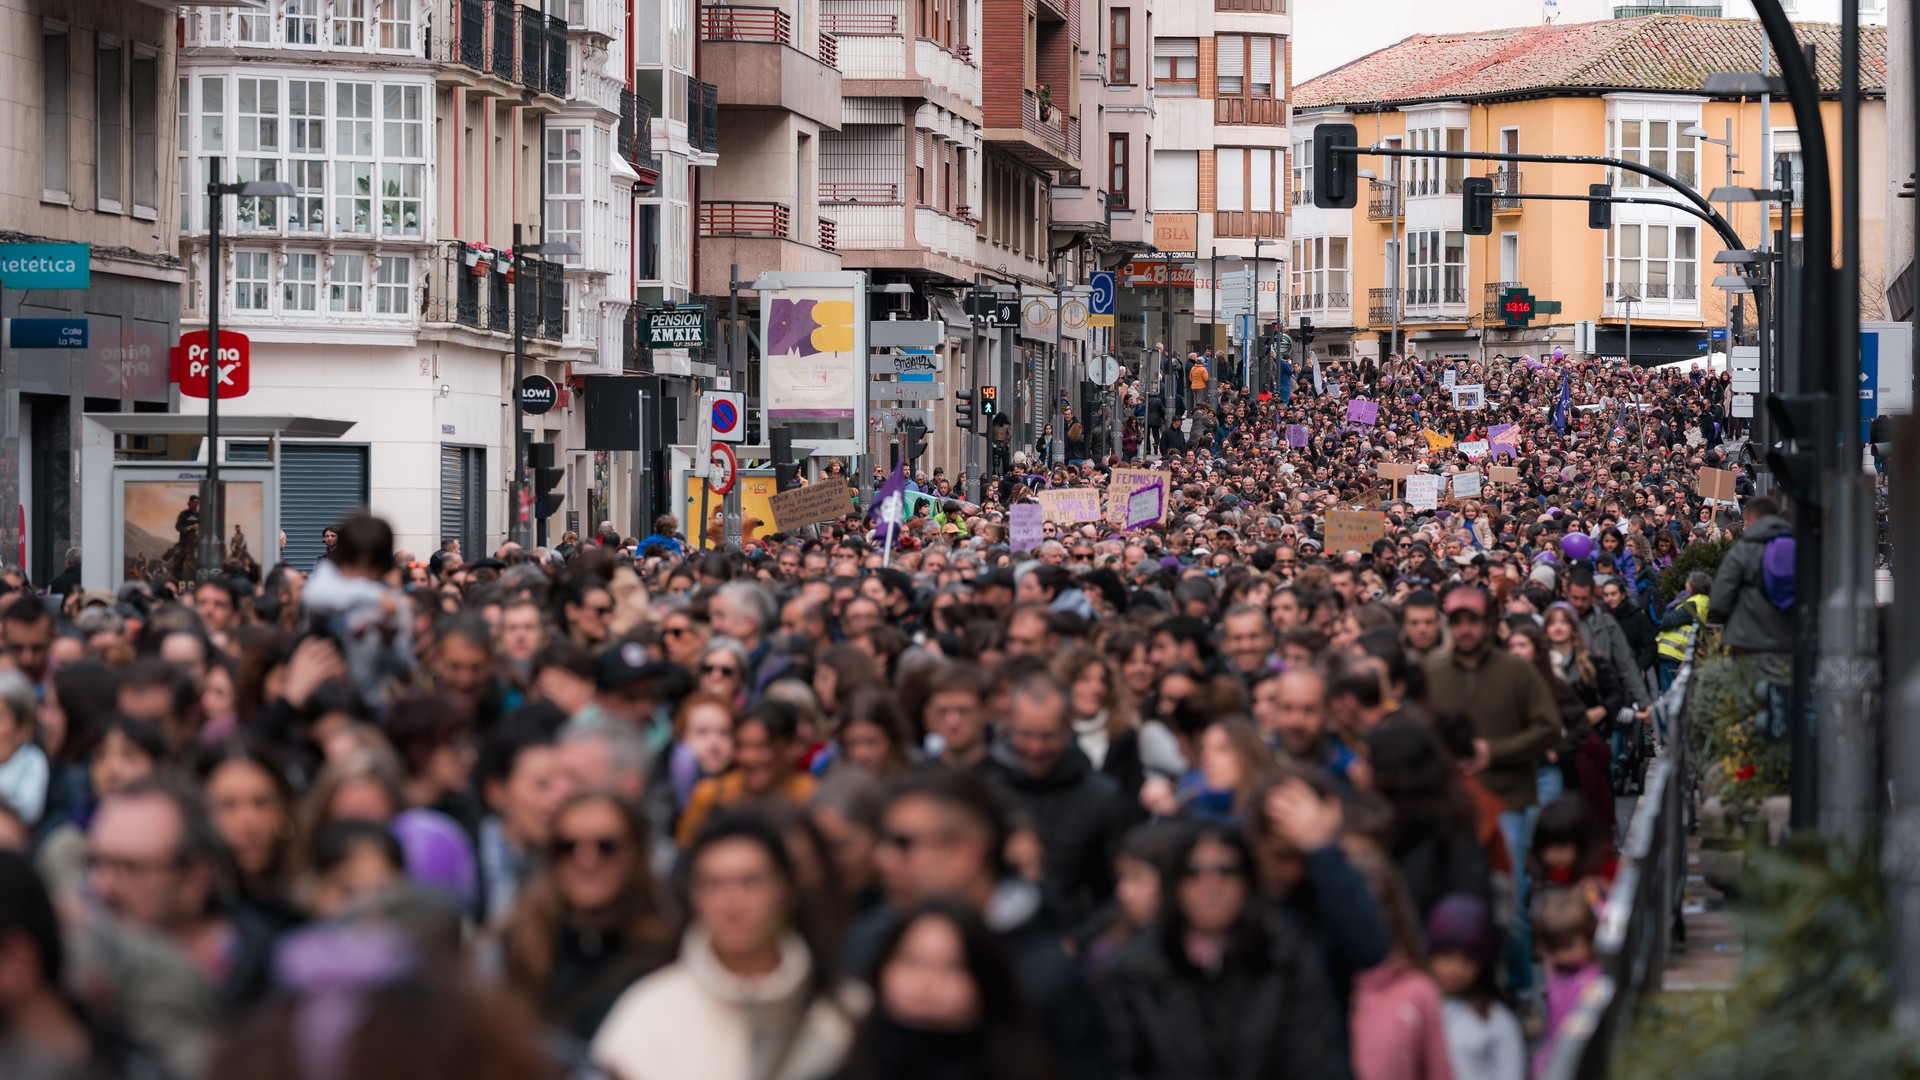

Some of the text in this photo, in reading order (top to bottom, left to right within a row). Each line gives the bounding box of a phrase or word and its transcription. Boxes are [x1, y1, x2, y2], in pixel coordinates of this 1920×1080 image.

[0, 256, 76, 273] ietética
[1506, 302, 1530, 312] 13:16
[650, 314, 702, 326] PENSION
[62, 327, 82, 336] Calle
[650, 328, 702, 342] AMAIA
[58, 338, 82, 346] La Paz
[188, 344, 240, 360] Prma
[983, 387, 995, 399] 49
[1116, 474, 1163, 486] FEMINISTA
